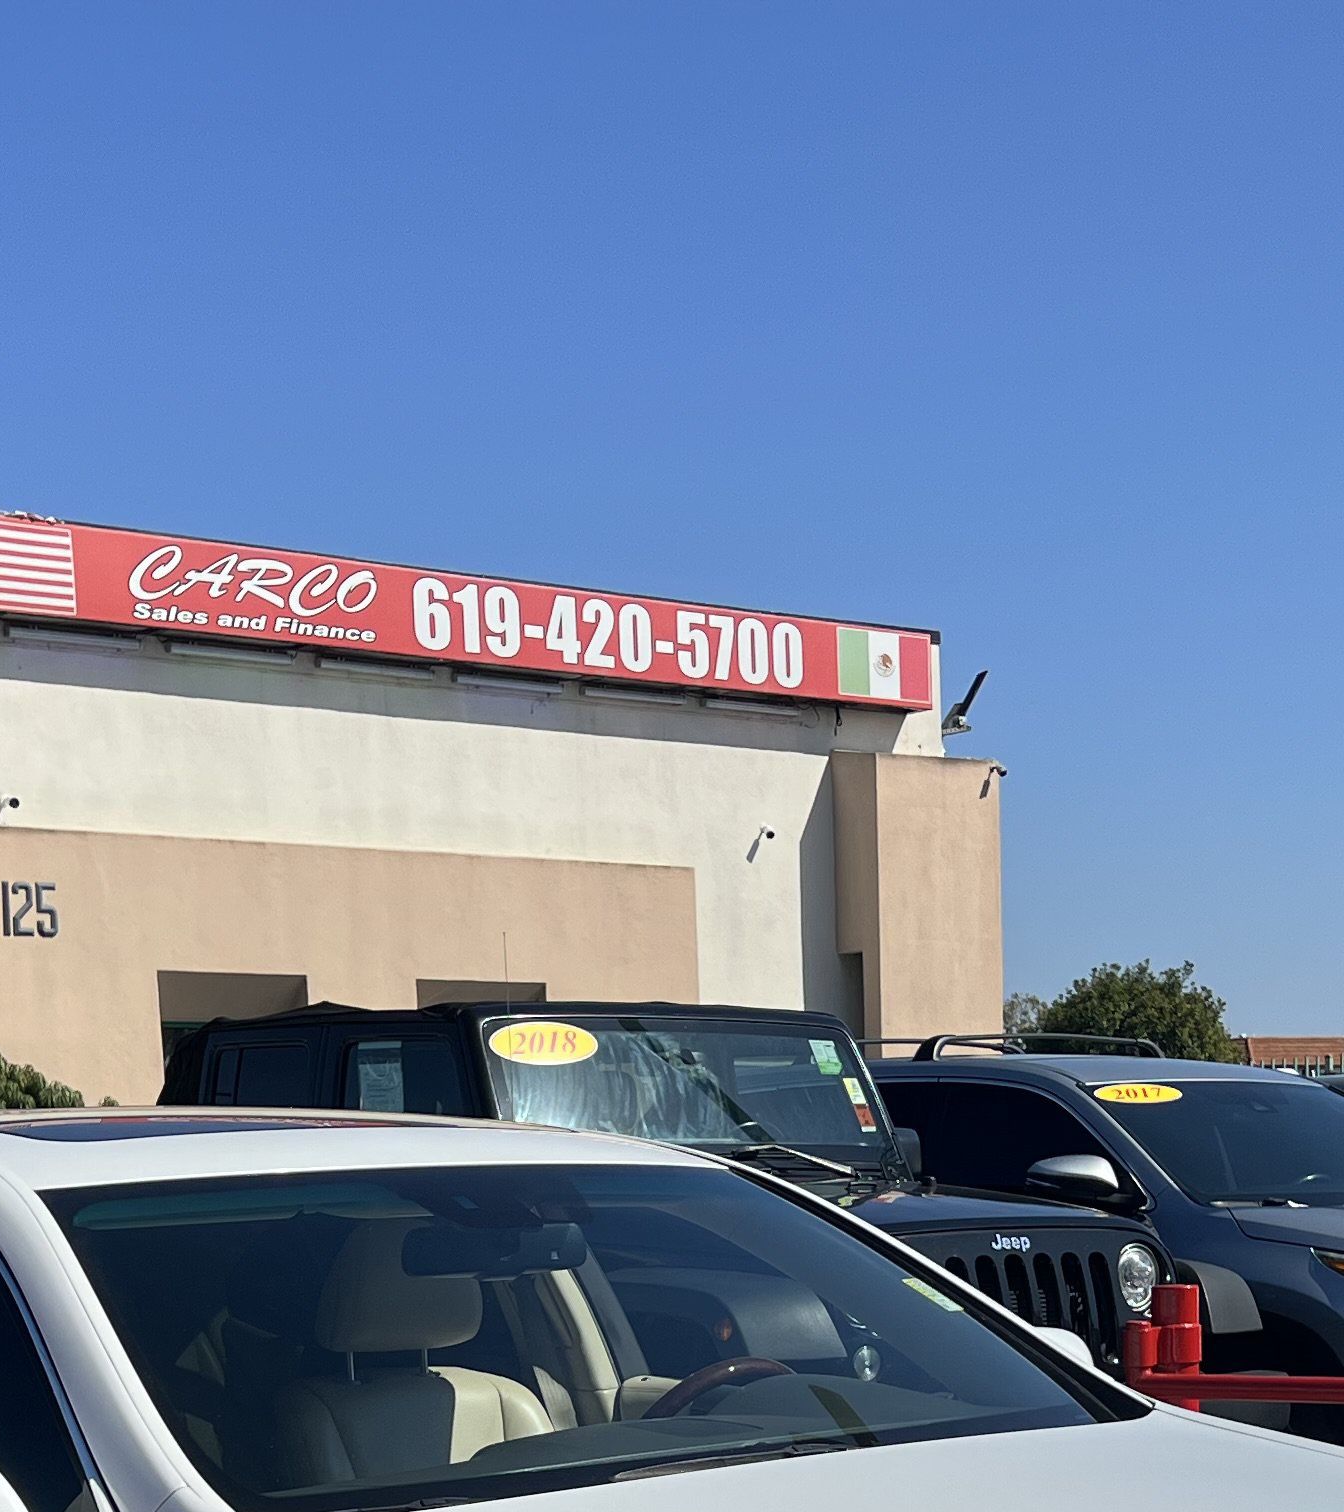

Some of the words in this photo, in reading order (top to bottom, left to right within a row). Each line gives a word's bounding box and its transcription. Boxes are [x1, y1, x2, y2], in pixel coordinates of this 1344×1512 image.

[127, 544, 379, 618] CARCO
[132, 602, 210, 626] Sales
[216, 612, 268, 632] and
[272, 616, 378, 643] Finance
[411, 576, 805, 689] 619-420-5700
[511, 1030, 577, 1055] 2018
[1111, 1087, 1161, 1100] 2017
[991, 1233, 1031, 1253] Jeep
